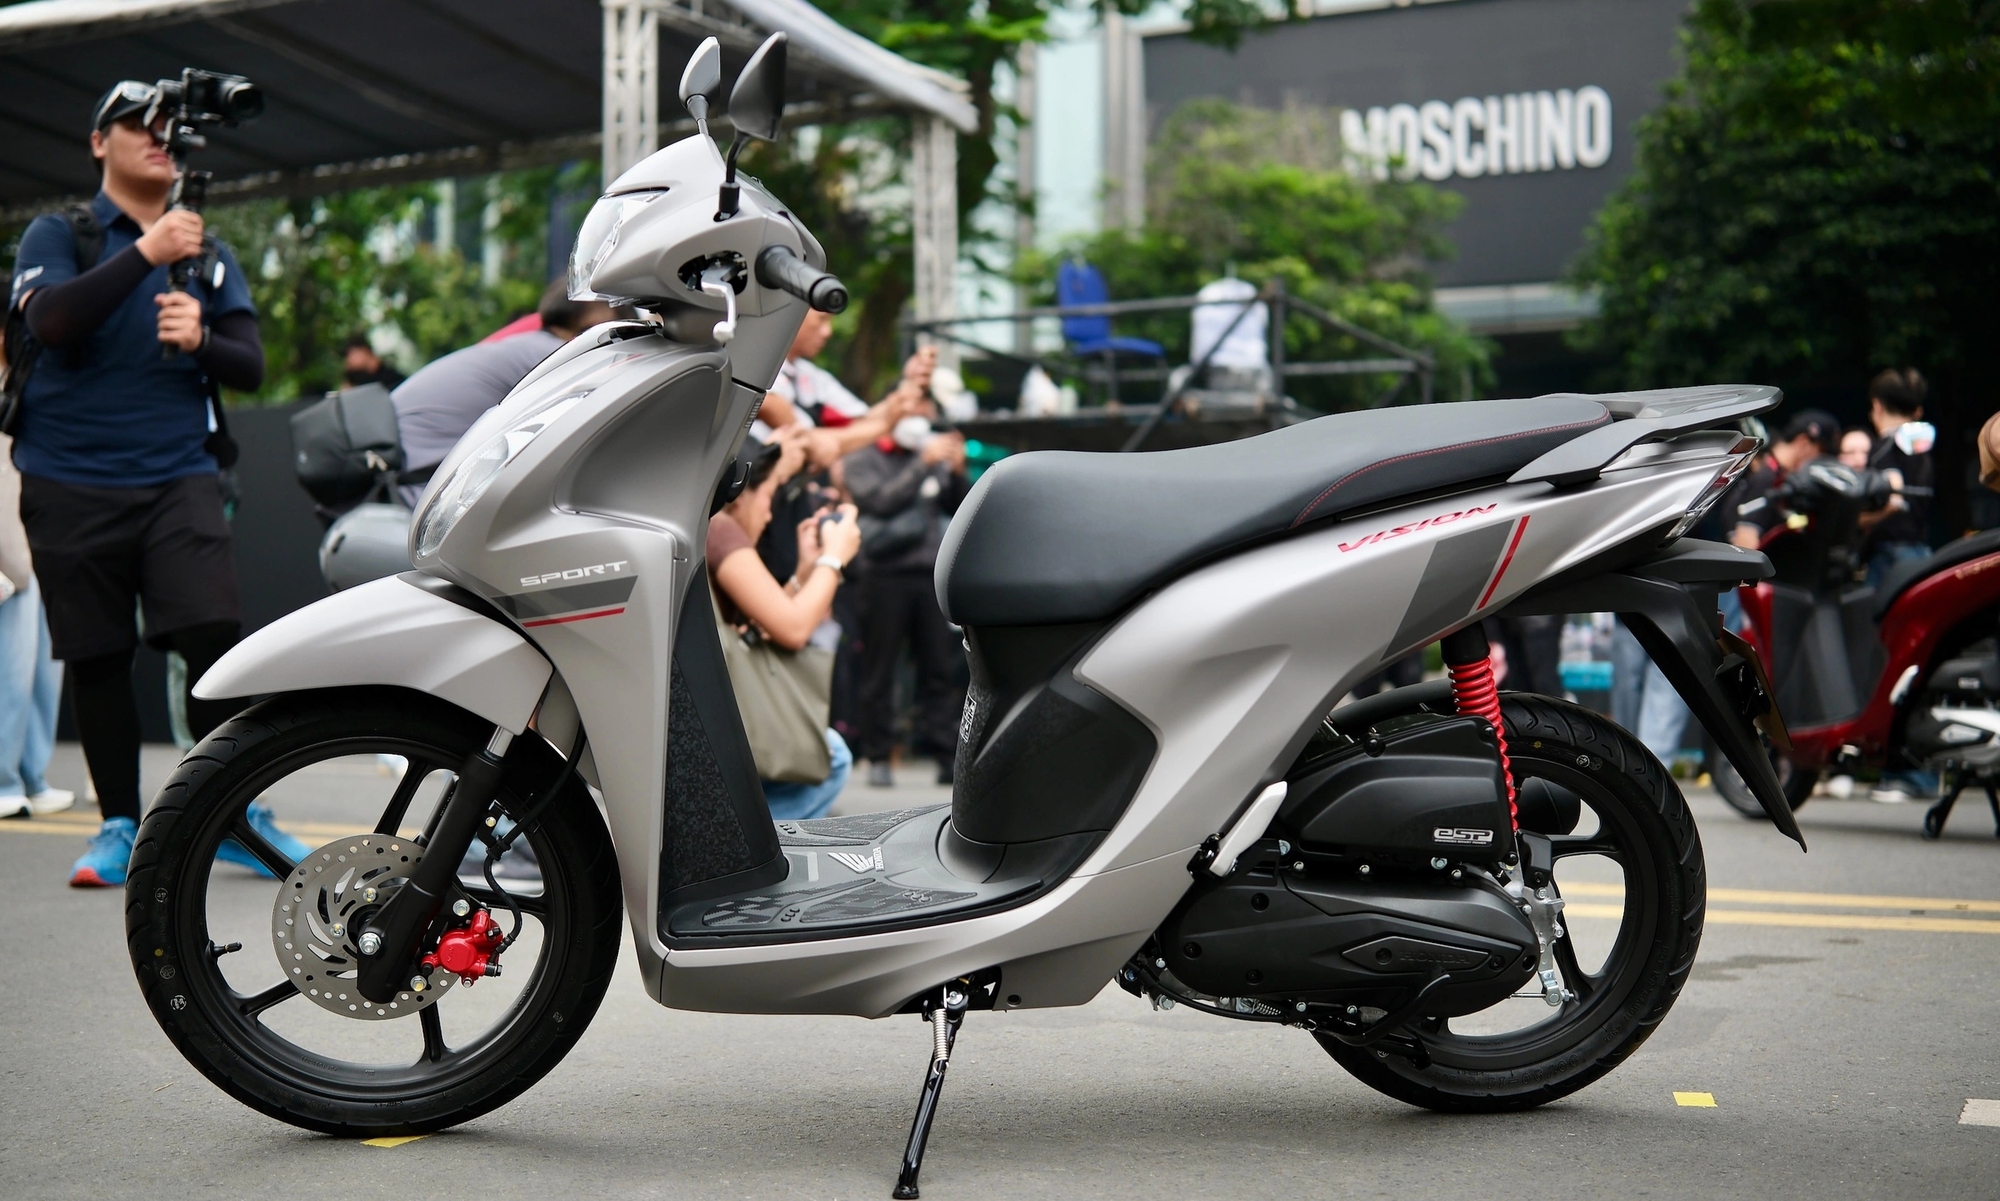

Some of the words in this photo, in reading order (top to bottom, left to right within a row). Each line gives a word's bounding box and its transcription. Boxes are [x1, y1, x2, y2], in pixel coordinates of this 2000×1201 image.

[1339, 85, 1612, 182] MOSCHINO
[1337, 503, 1498, 553] VISION
[519, 560, 628, 587] SPORT
[1399, 951, 1471, 965] HONDA
